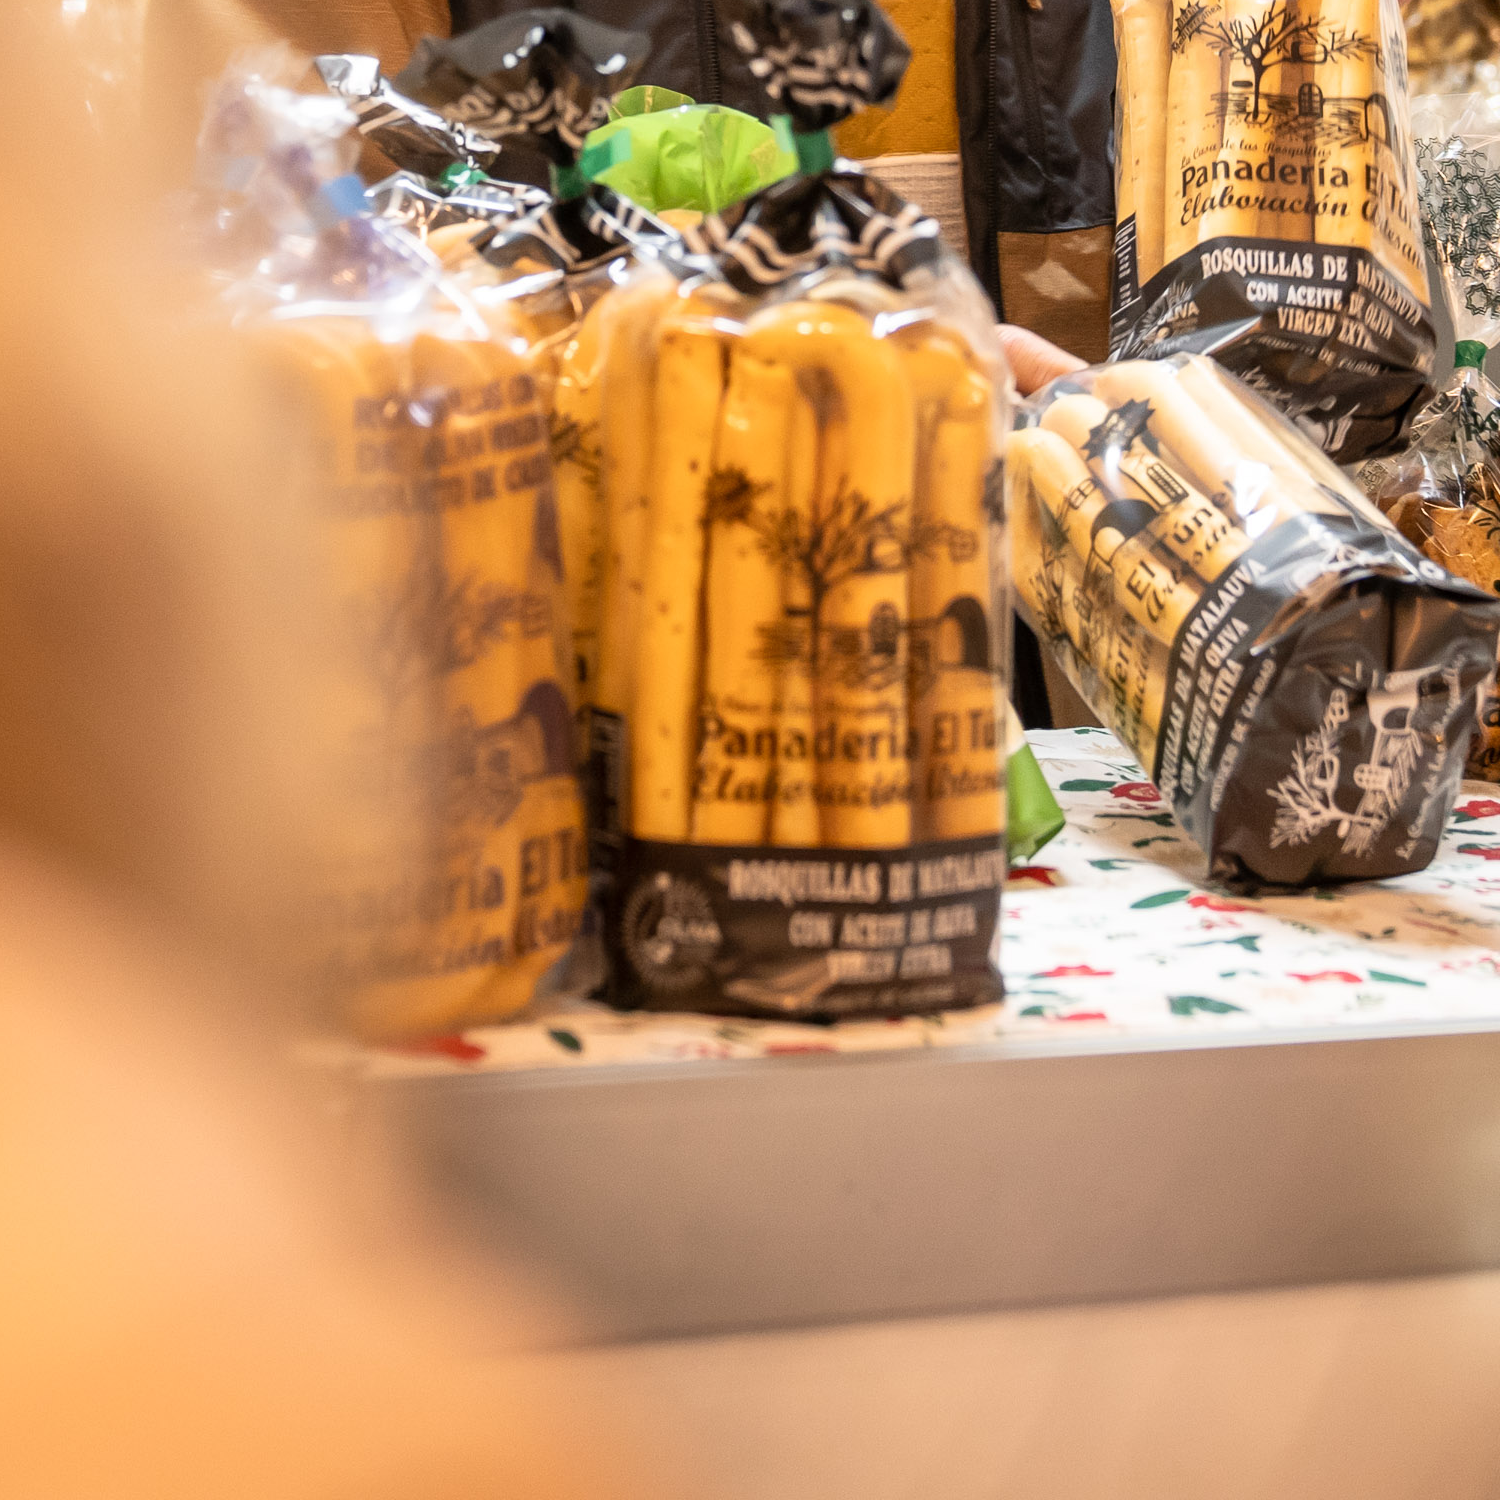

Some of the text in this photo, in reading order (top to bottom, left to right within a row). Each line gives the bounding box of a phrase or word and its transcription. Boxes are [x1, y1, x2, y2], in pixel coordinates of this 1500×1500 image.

[1181, 155, 1349, 198] Panadería
[1365, 164, 1384, 199] El
[1180, 185, 1350, 226] Elaboración
[1200, 246, 1423, 326] ROSQUILLAS DE MATALAUVA
[1246, 281, 1394, 341] CON ACEITE DE OLIVA
[1277, 306, 1337, 336] VIRGEN
[1125, 560, 1156, 601] El
[1180, 558, 1267, 671] MATALAUVA
[1204, 616, 1250, 669] OLIVA
[1175, 667, 1192, 703] DE
[1197, 665, 1214, 697] DE
[1209, 657, 1244, 719] EXTRA
[728, 859, 883, 907] ROSQUILLAS
[789, 911, 834, 947] CON
